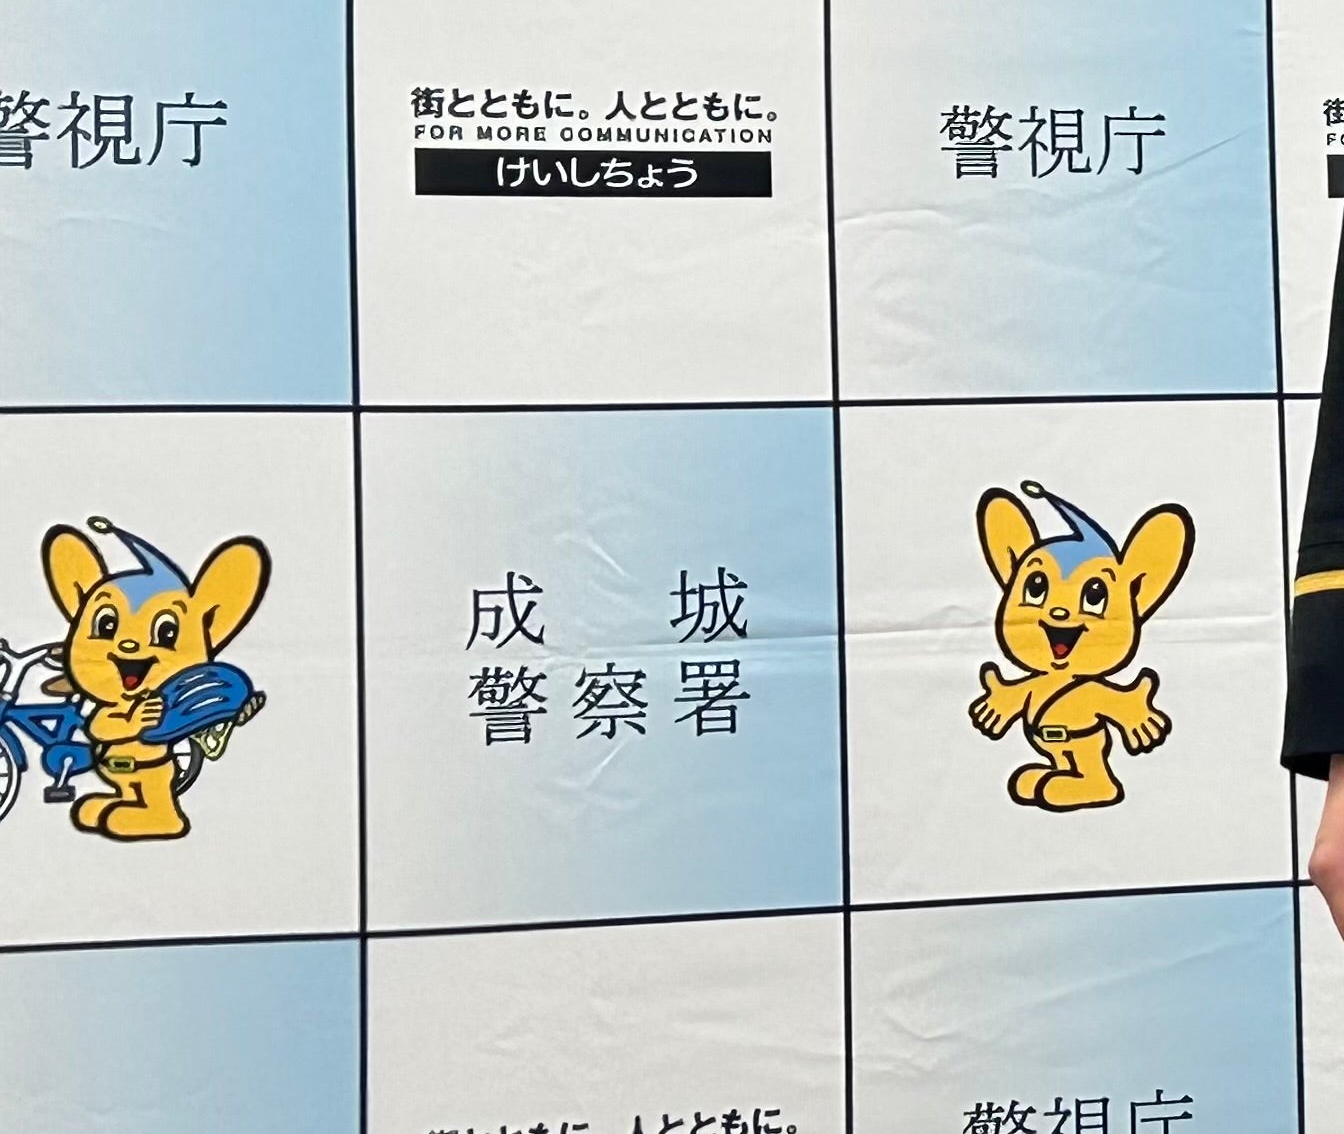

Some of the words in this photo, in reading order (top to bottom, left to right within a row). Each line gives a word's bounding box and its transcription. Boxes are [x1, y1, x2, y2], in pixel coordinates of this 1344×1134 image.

[0, 90, 227, 170] 警視庁
[411, 87, 777, 121] 街とともに。人とともに。
[415, 125, 462, 140] FOR
[477, 126, 546, 141] MORE
[560, 127, 771, 143] COMMUNICATION
[940, 105, 1165, 179] 警視庁
[497, 157, 697, 188] けいしちょう
[468, 659, 750, 746] 警察署
